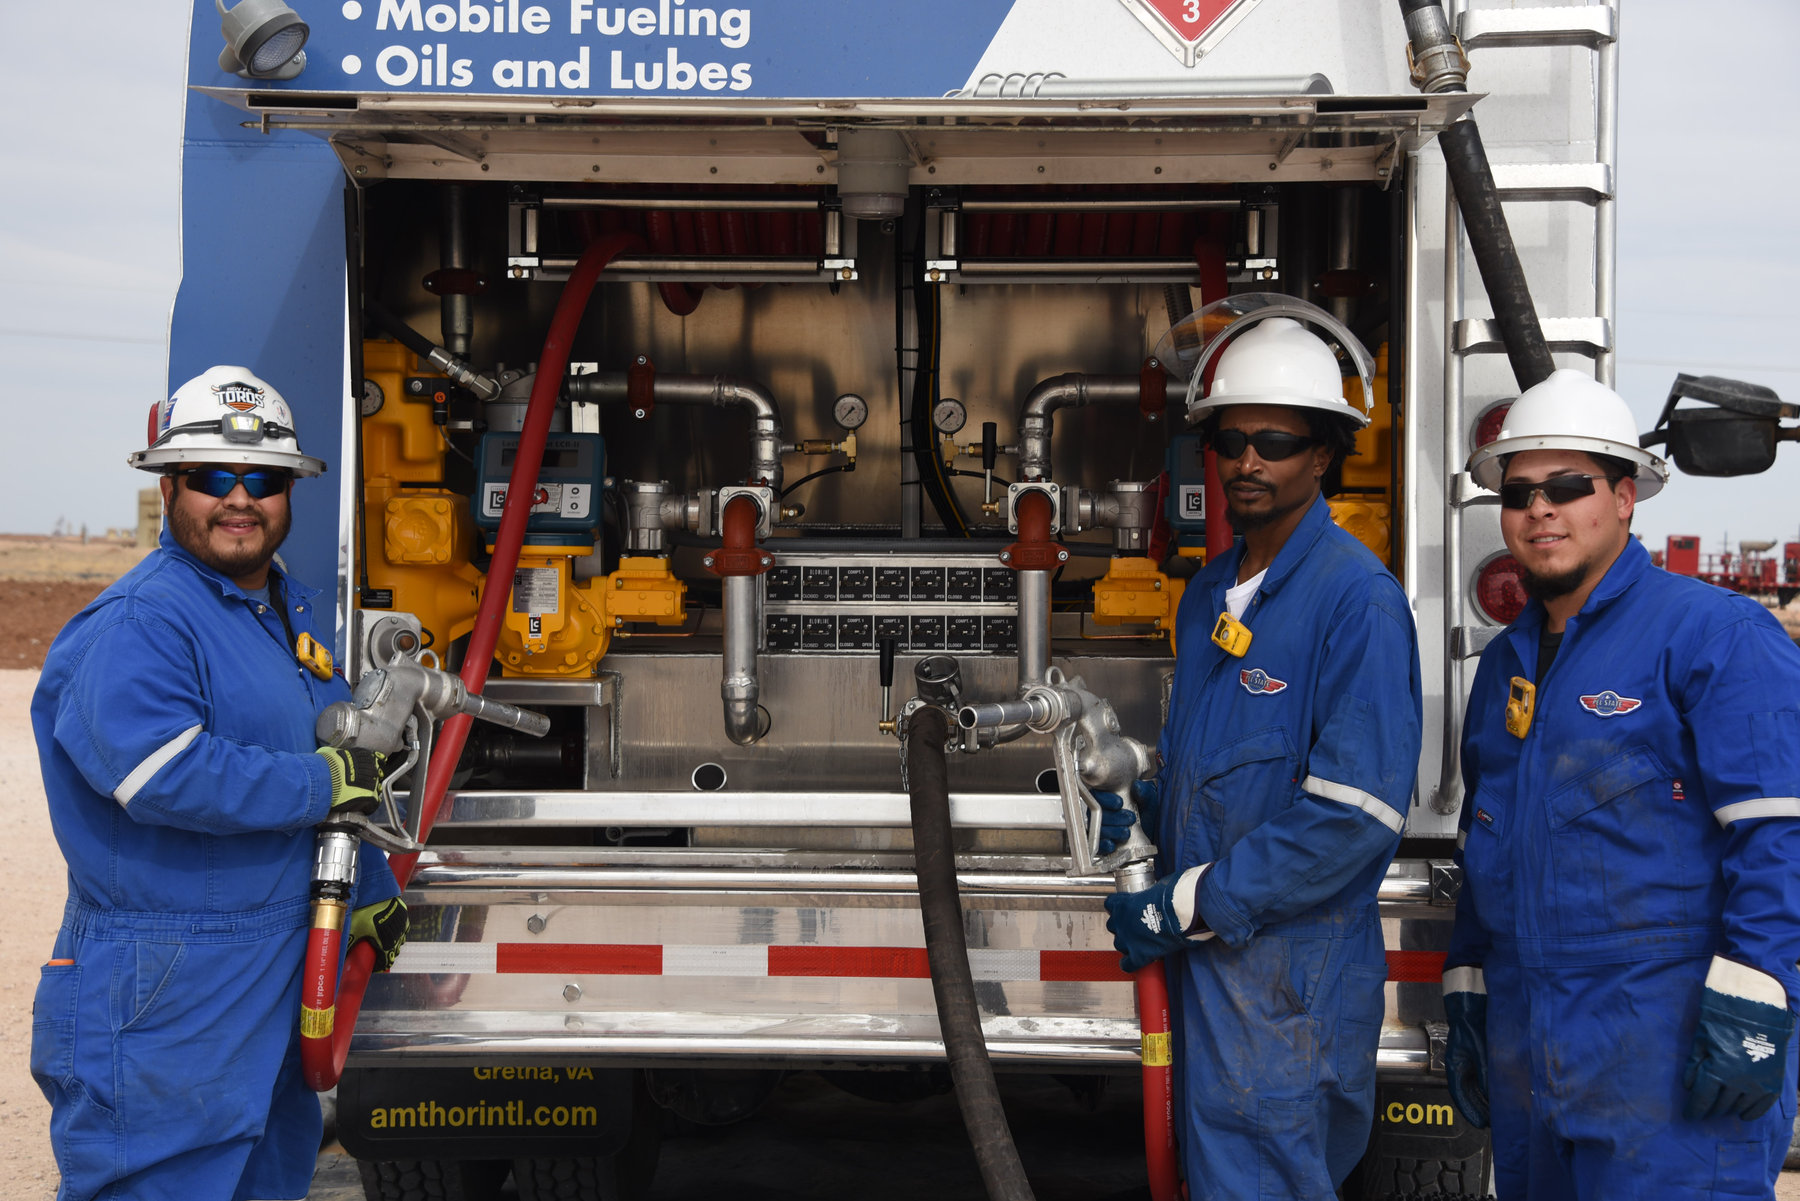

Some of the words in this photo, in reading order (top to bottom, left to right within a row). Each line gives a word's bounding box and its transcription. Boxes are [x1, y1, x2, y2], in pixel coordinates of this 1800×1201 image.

[376, 0, 551, 35] Mobile
[571, 0, 751, 48] Fueling
[1182, 0, 1200, 23] 3
[376, 44, 474, 87] Oils
[493, 47, 590, 88] and
[611, 48, 753, 91] Lubes
[213, 390, 265, 408] TOROS
[473, 1067, 560, 1083] Gretna,
[566, 1067, 594, 1080] VA
[370, 1100, 597, 1129] amthorintl.com
